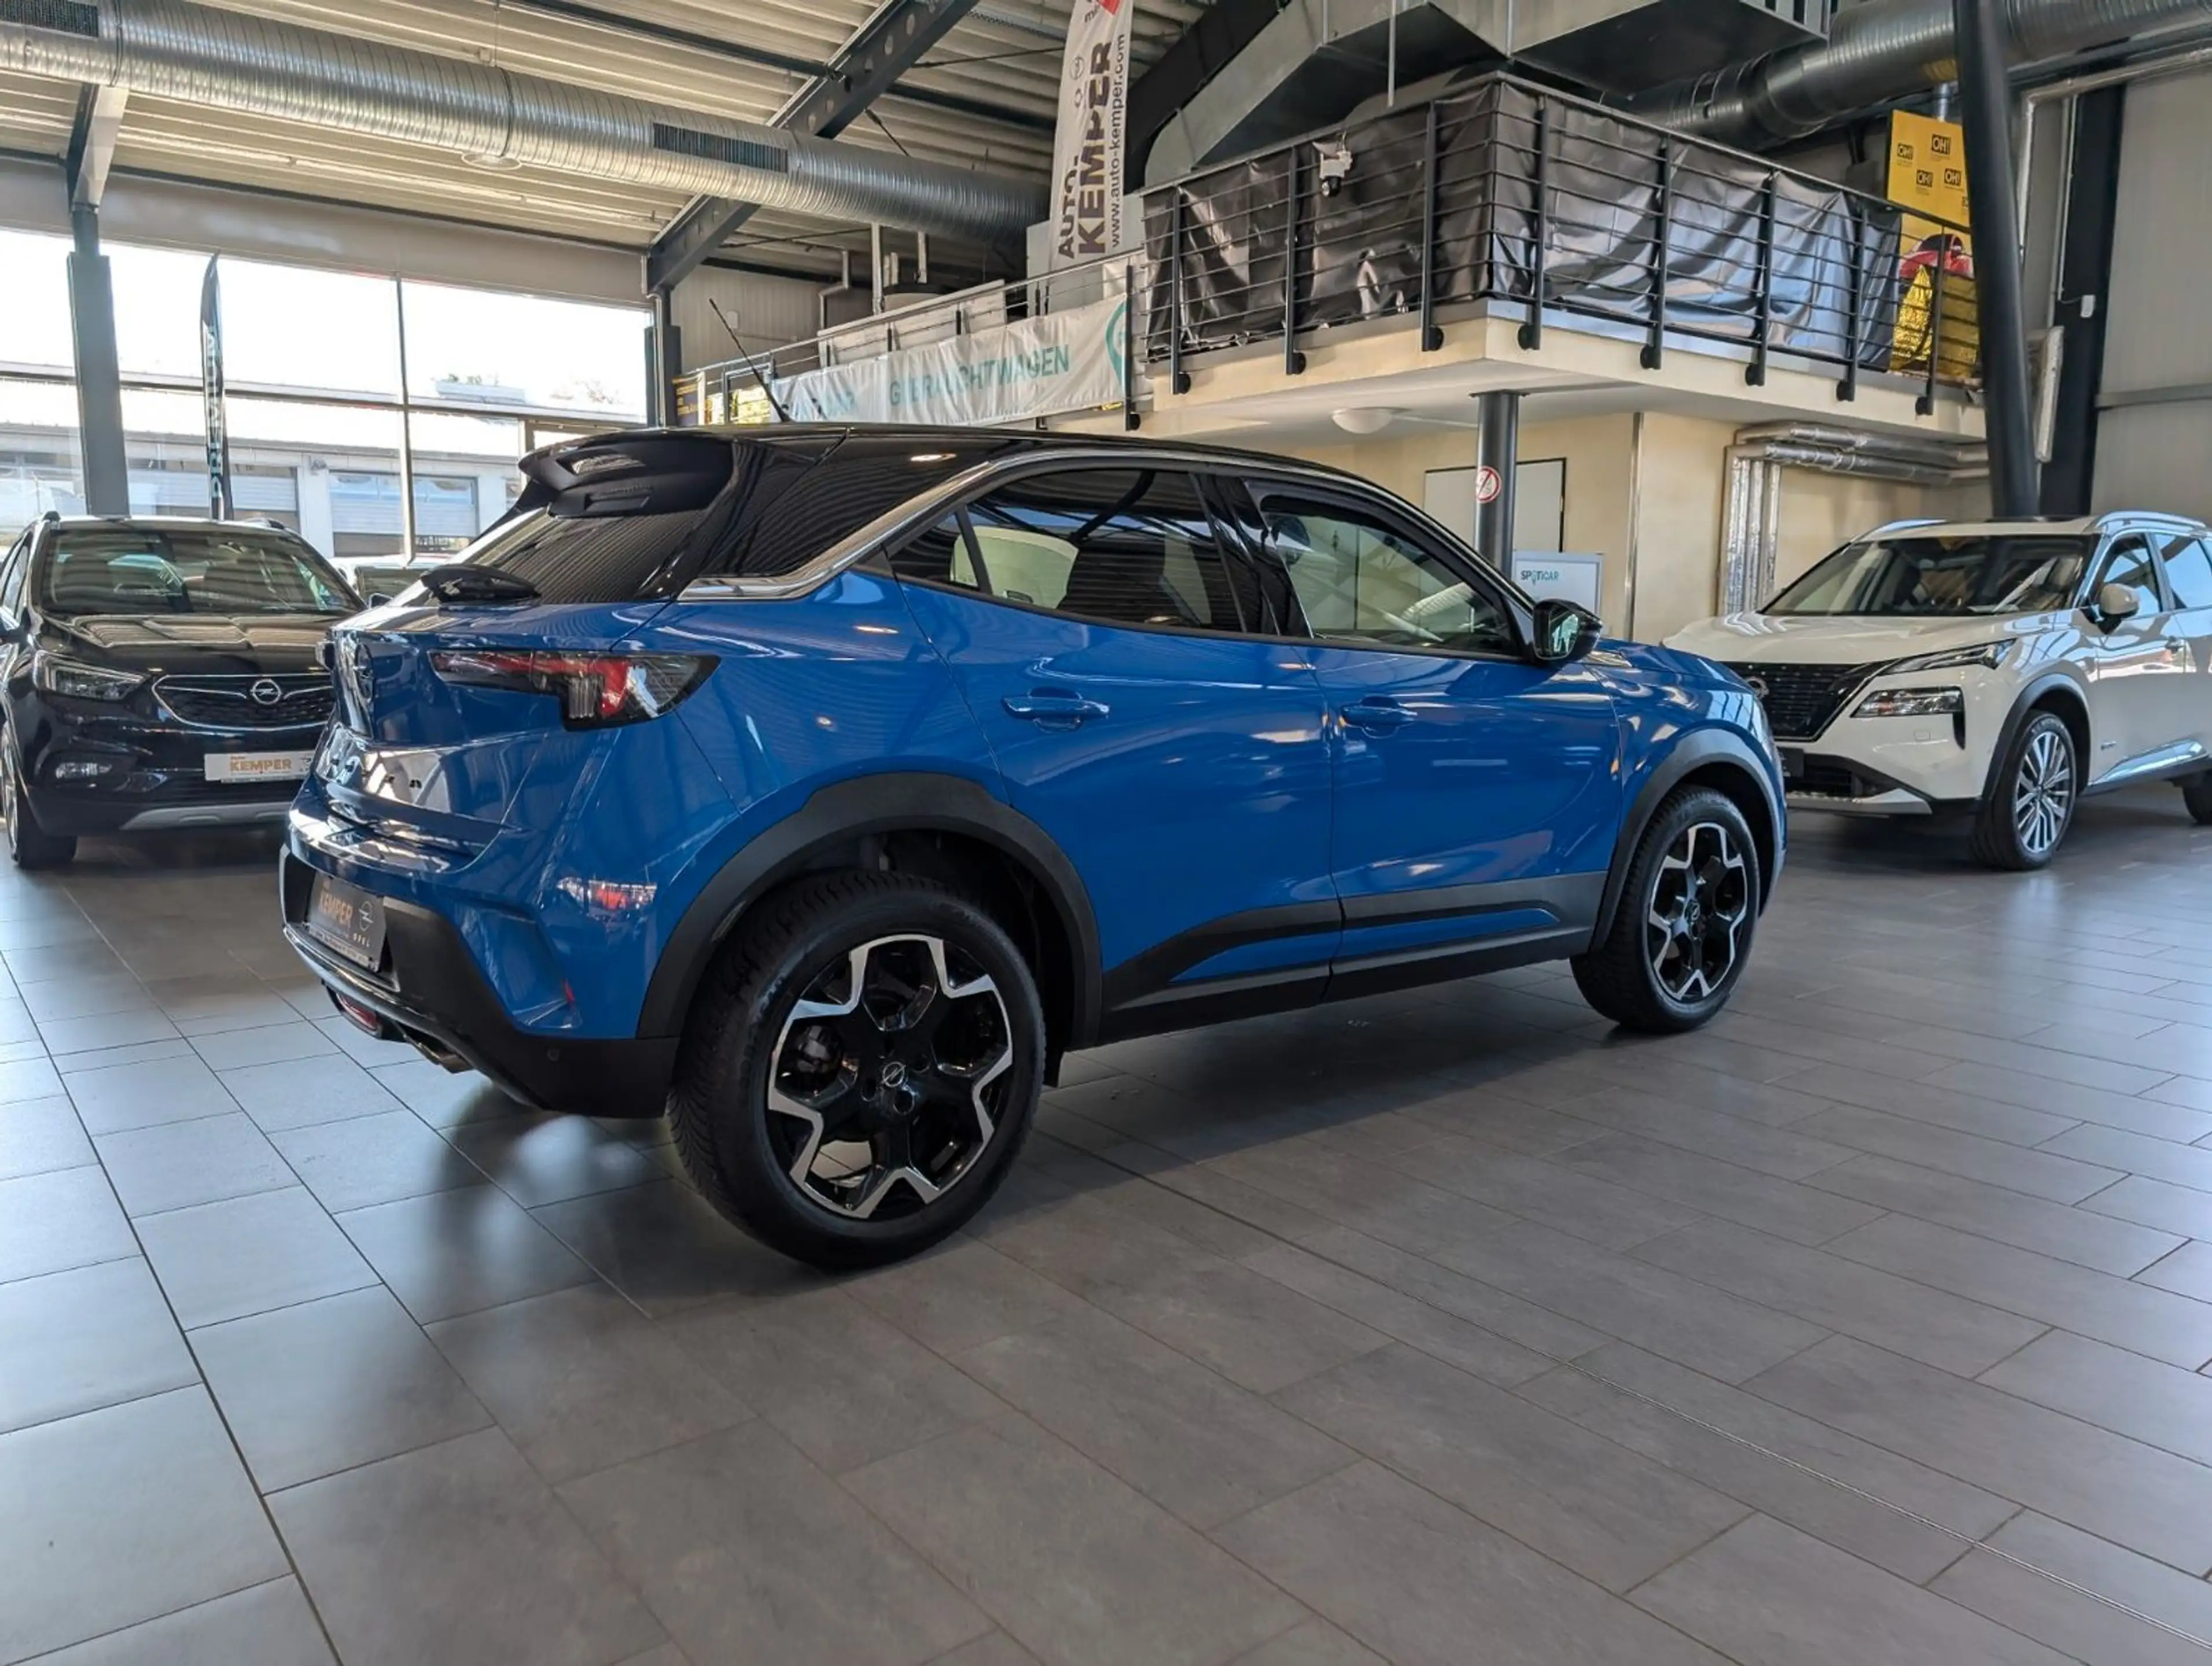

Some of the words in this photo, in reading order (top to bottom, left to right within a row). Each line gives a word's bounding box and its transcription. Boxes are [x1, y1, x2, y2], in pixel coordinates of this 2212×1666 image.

[1058, 156, 1078, 259] AUTO-
[1079, 42, 1111, 254] KEMPER
[1110, 34, 1125, 248] www.auto-kemper.com
[230, 758, 292, 772] KEMPER
